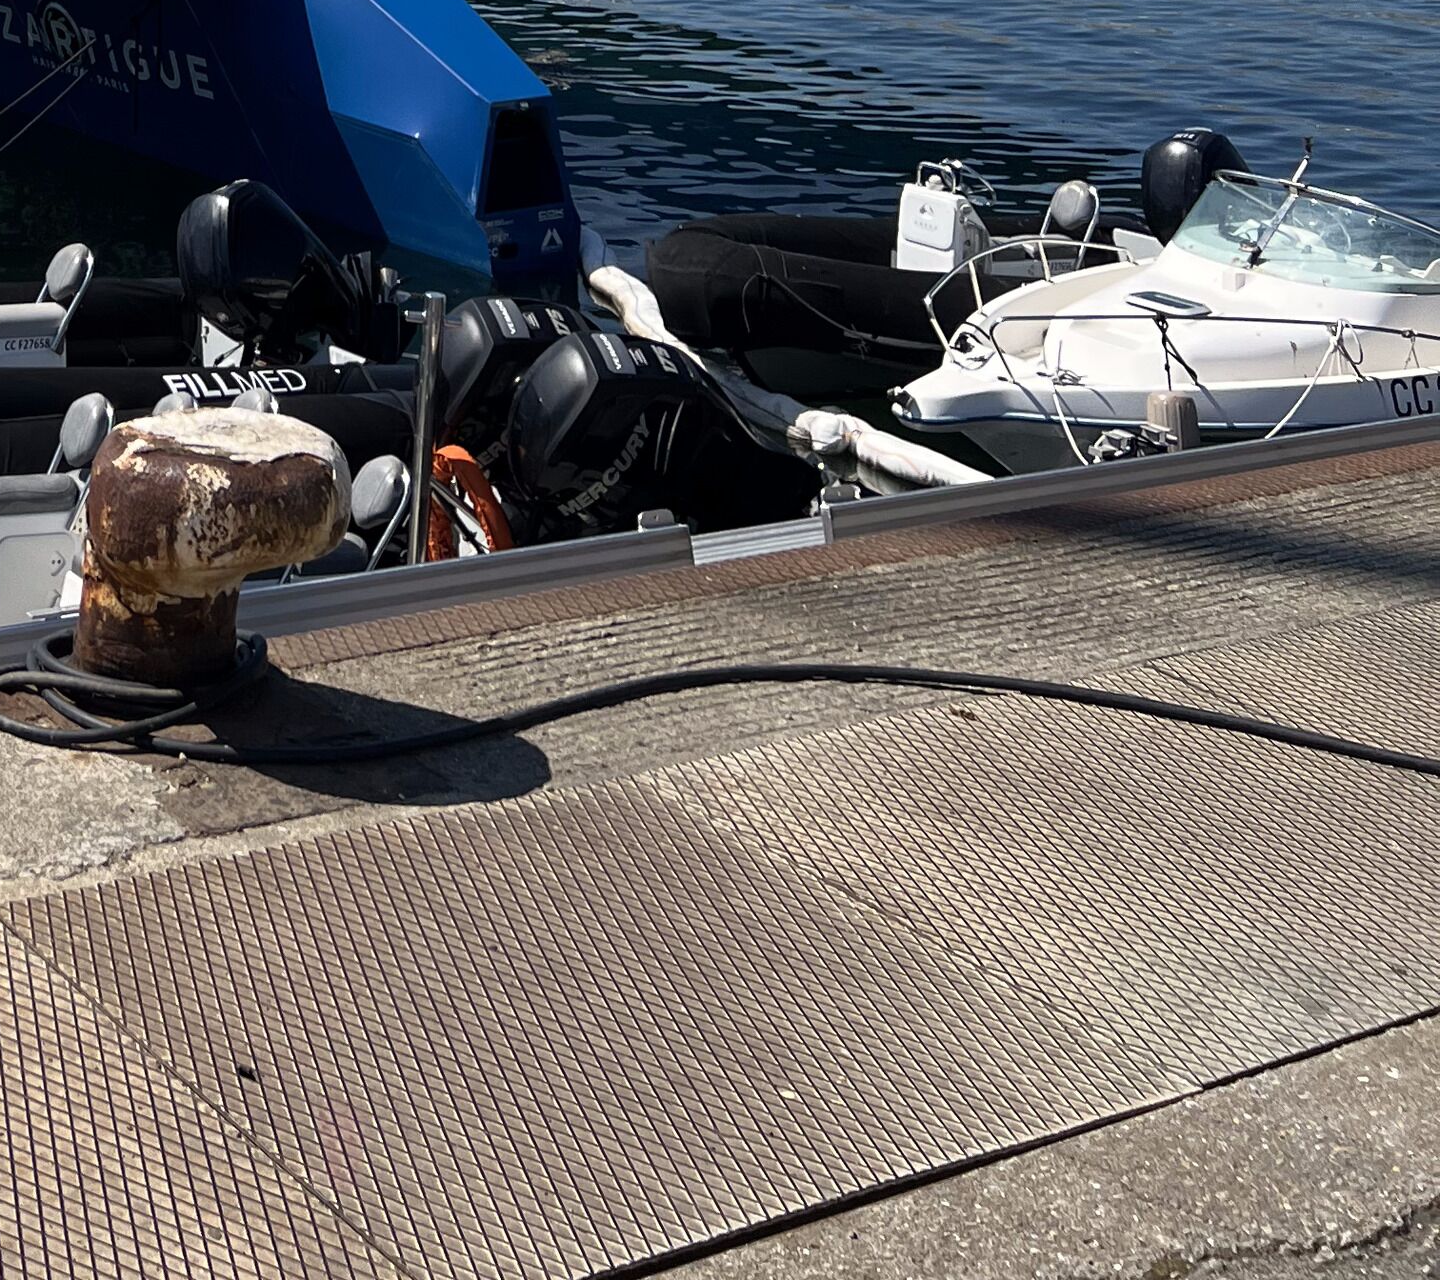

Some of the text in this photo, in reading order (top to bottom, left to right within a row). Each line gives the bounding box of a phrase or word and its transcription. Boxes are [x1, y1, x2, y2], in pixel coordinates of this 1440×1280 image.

[162, 369, 306, 398] FILLMED
[1391, 375, 1433, 417] CC
[558, 412, 650, 517] MERCURY
